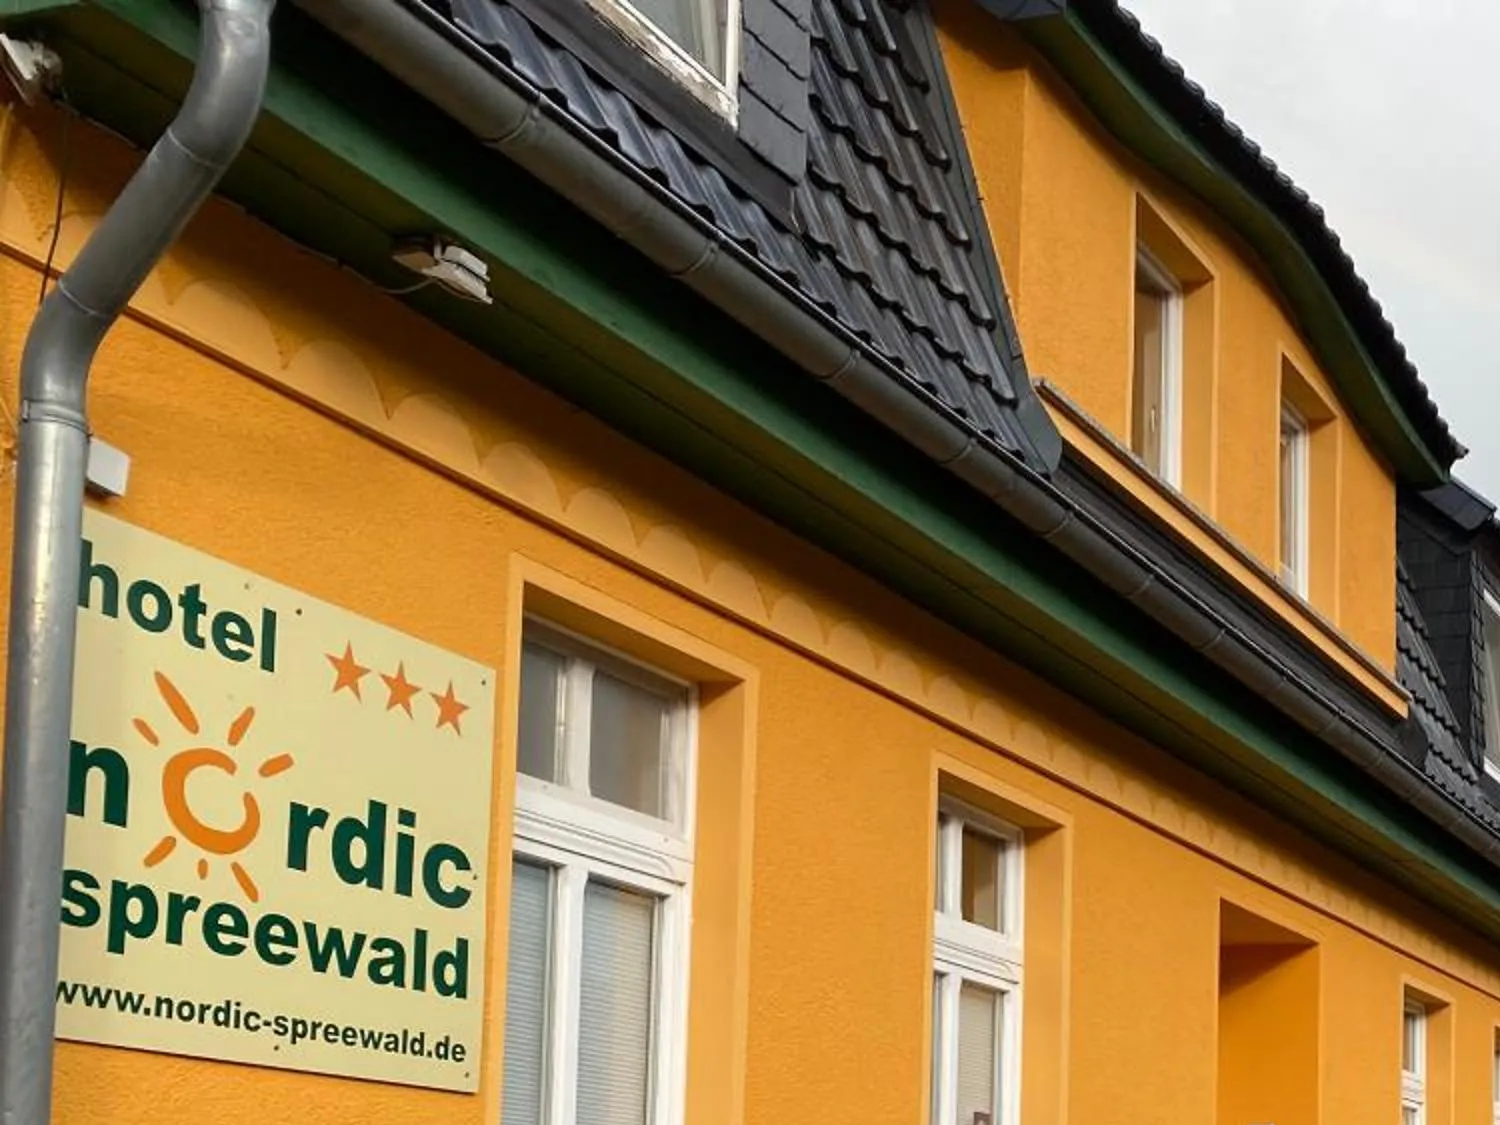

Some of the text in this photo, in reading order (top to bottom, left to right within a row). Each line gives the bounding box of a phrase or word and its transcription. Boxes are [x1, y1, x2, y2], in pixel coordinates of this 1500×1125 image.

[77, 538, 277, 673] hotel
[60, 868, 469, 999] spreewald
[56, 981, 466, 1063] www.nordic-spreewald.de
